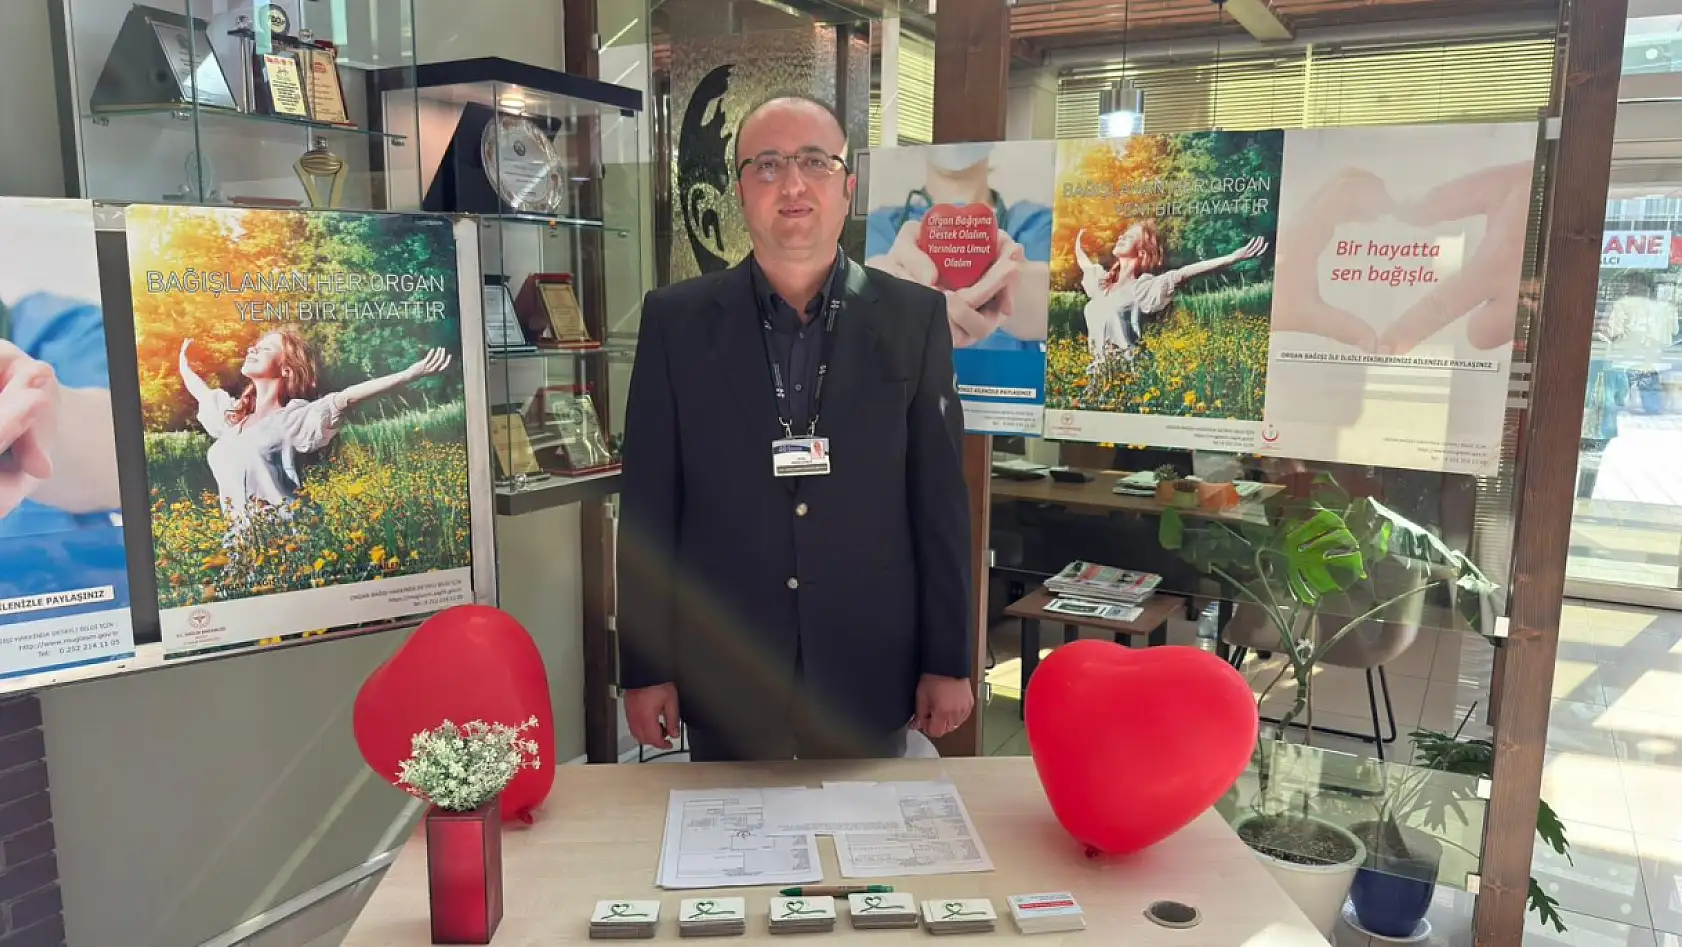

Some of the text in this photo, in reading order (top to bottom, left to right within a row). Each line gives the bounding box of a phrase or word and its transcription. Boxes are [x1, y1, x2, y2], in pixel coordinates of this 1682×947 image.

[1210, 177, 1271, 193] ORGAN
[1188, 199, 1269, 215] HAYATTIR
[927, 215, 954, 227] Organ
[929, 229, 990, 241] Destek Olalım,
[928, 244, 991, 254] Yarınlara Umut
[1336, 240, 1440, 261] Bir hayatta
[944, 257, 972, 268] Olalım
[146, 268, 445, 298] BAĞIŞLANAN HER ORGAN
[1331, 265, 1439, 287] sen bağışla.
[344, 300, 446, 321] HAYATTIR
[46, 590, 105, 604] PAYLAŞINIZ
